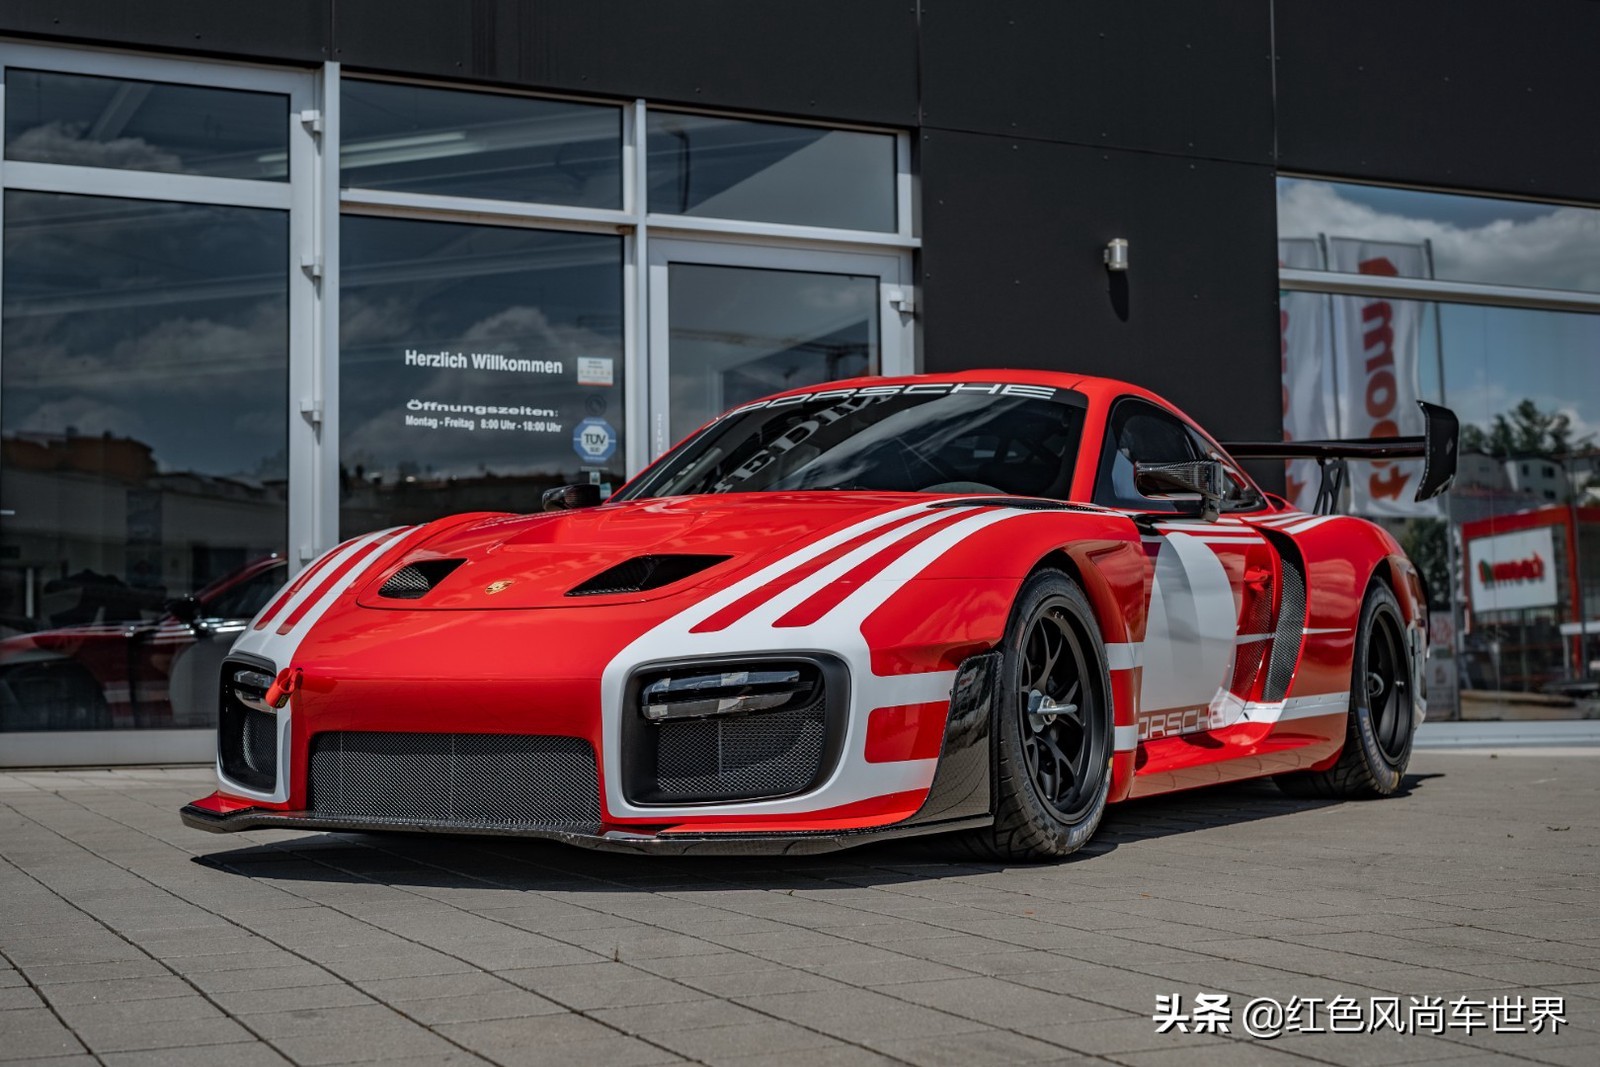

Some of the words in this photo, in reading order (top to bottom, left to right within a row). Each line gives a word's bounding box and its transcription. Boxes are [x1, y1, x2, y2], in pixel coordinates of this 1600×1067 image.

[405, 349, 468, 369] Herzlich
[471, 353, 563, 375] Willkommen
[406, 399, 559, 417] Öffnungszeiten:
[726, 382, 1056, 419] PORSCHE
[405, 415, 438, 429] Montag
[444, 417, 475, 431] Freitag
[480, 419, 499, 430] 8:00
[501, 420, 516, 430] Uhr
[523, 421, 545, 432] 18:00
[547, 422, 562, 433] Uhr
[584, 432, 606, 445] TÜV
[1138, 700, 1224, 739] ORSCHE
